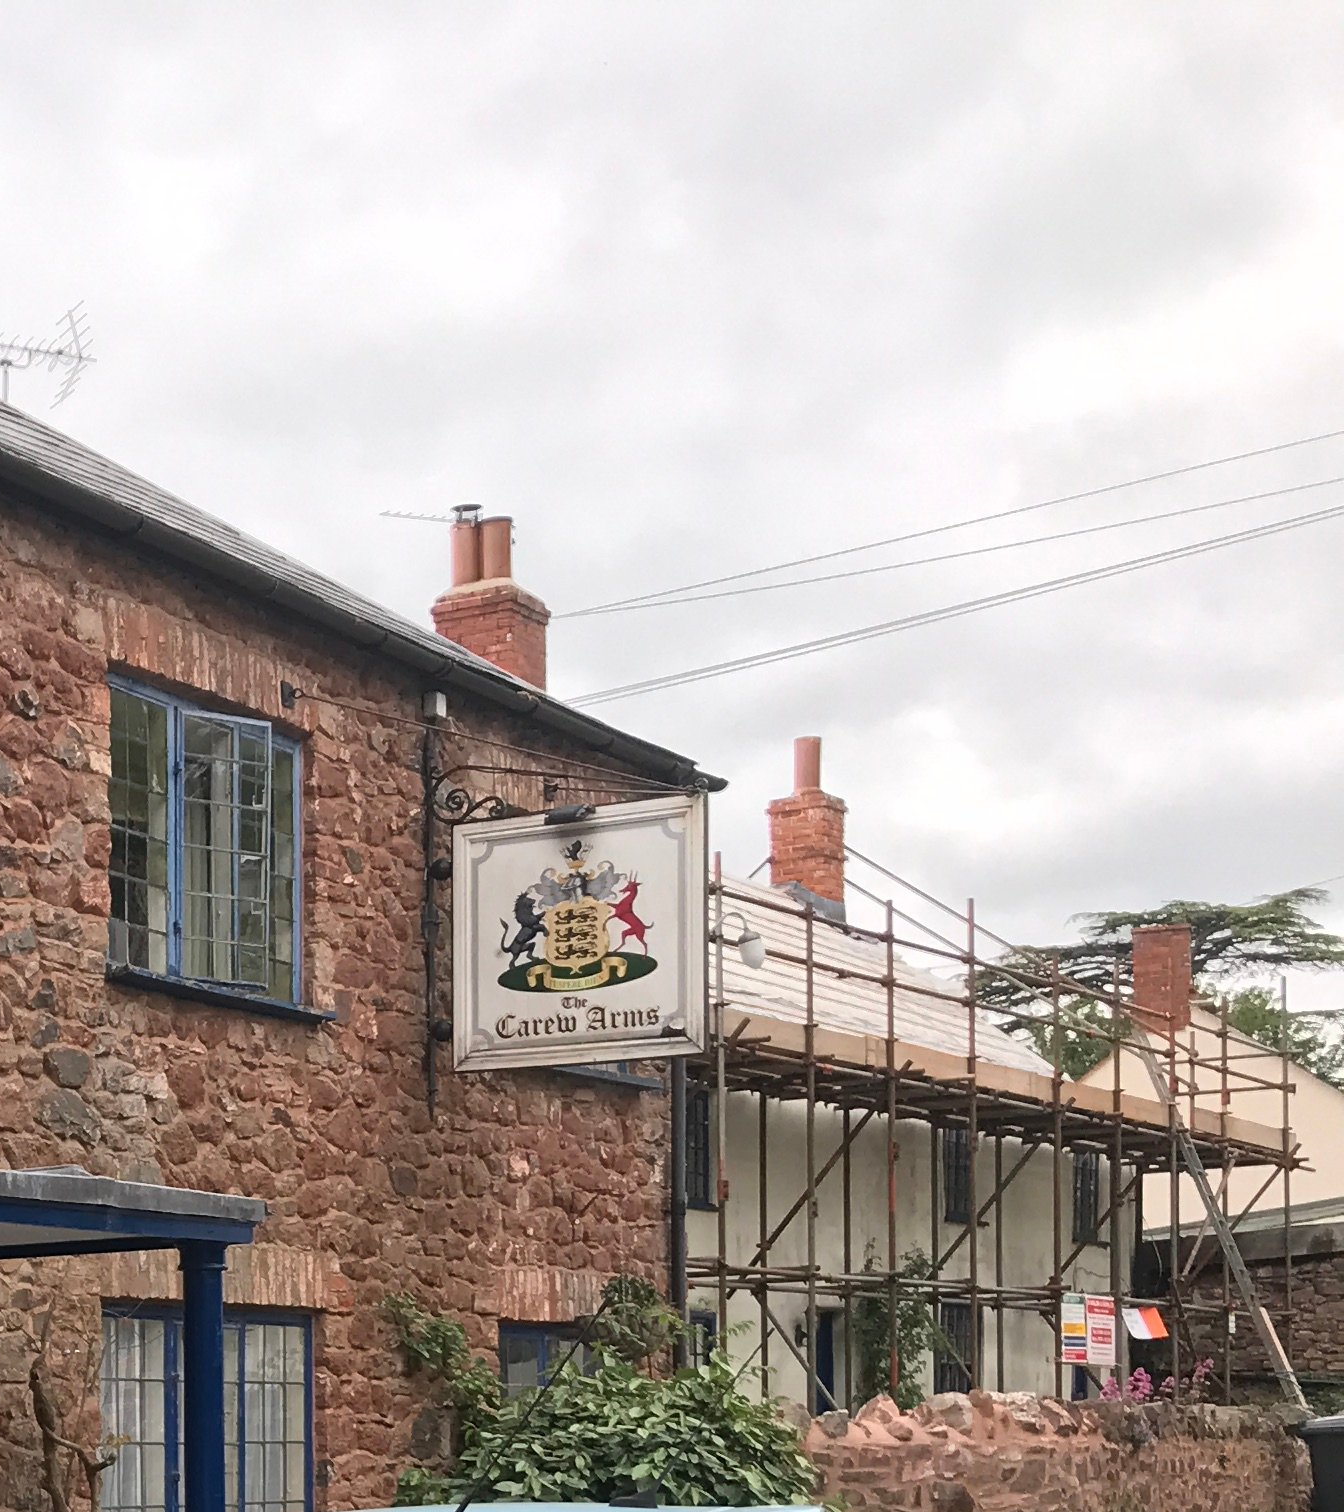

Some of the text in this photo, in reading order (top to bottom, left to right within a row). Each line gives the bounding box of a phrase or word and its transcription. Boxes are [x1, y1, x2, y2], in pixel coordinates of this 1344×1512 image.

[561, 996, 588, 1010] The
[495, 1005, 660, 1039] Carew Arms
